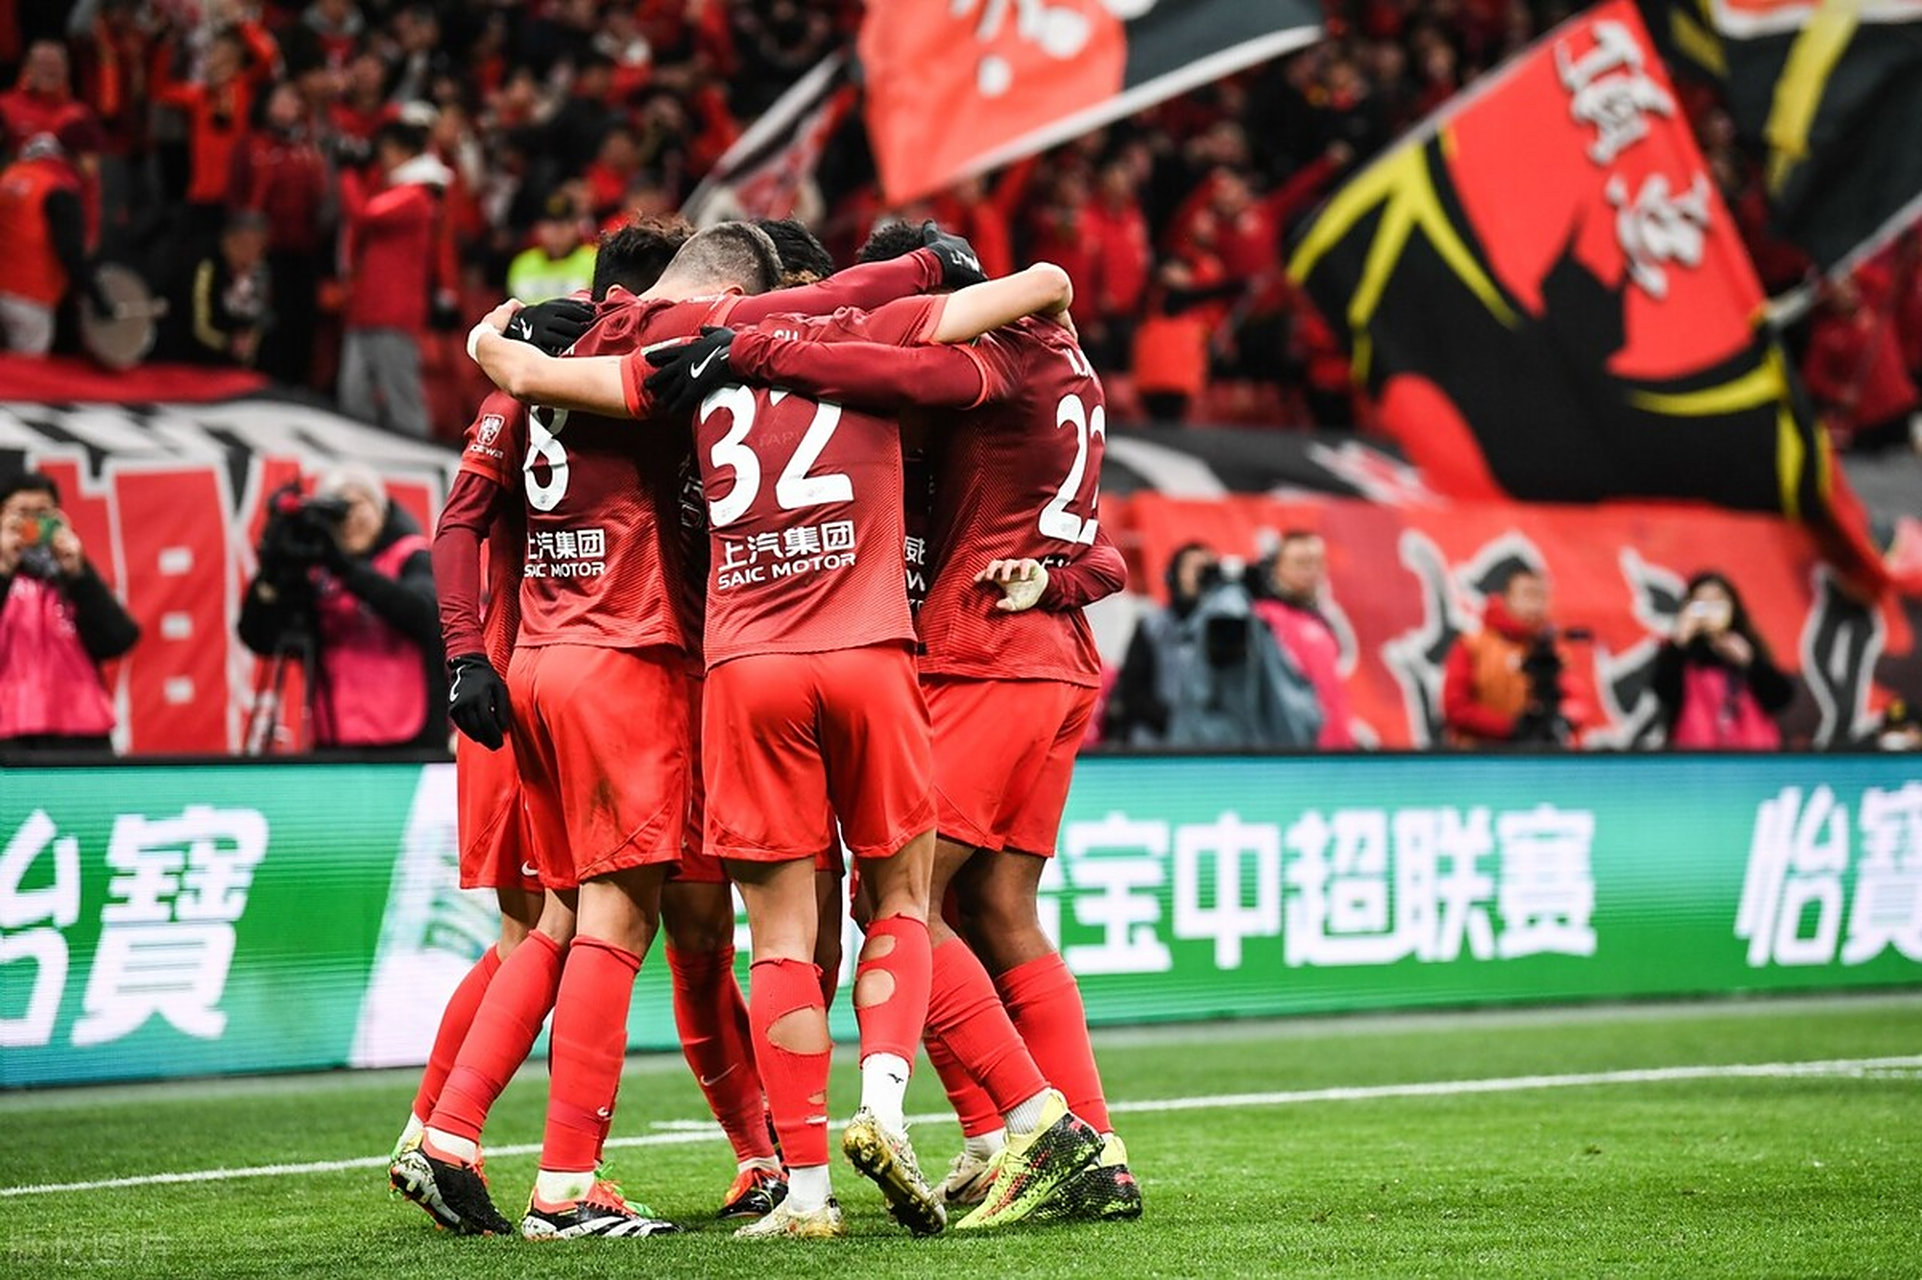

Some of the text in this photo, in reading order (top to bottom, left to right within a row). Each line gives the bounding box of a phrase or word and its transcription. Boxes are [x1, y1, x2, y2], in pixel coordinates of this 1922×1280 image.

[522, 405, 569, 511] 8
[701, 384, 854, 527] 32
[527, 529, 606, 559] 上汽集团
[550, 561, 606, 577] MOTOR
[718, 520, 856, 573] 上汽集团
[717, 552, 857, 591] SAIC MOTOR
[1037, 804, 1597, 975] 宝中超联赛
